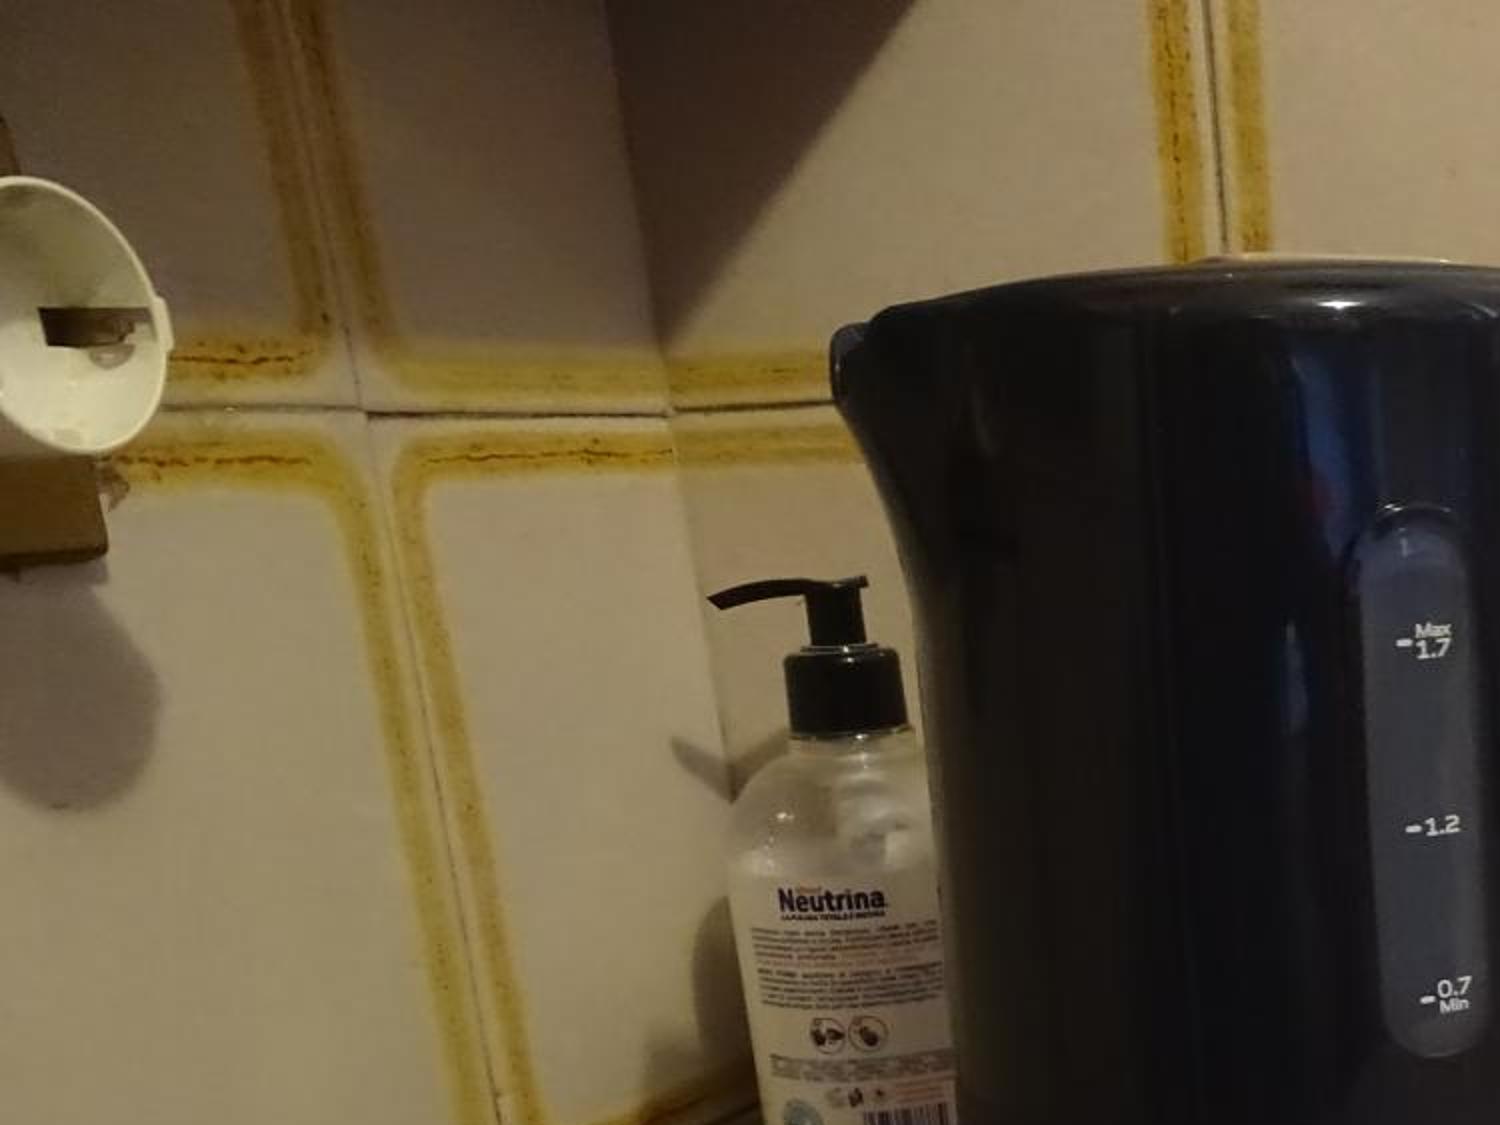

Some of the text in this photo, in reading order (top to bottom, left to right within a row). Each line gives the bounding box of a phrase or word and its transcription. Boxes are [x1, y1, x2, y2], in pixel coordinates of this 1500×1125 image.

[1415, 621, 1451, 639] Max
[1415, 638, 1451, 659] 1.7
[1425, 815, 1460, 837] 1.2
[777, 887, 885, 912] Neutrina
[1437, 976, 1472, 999] 0.7
[1439, 997, 1470, 1013] Min
